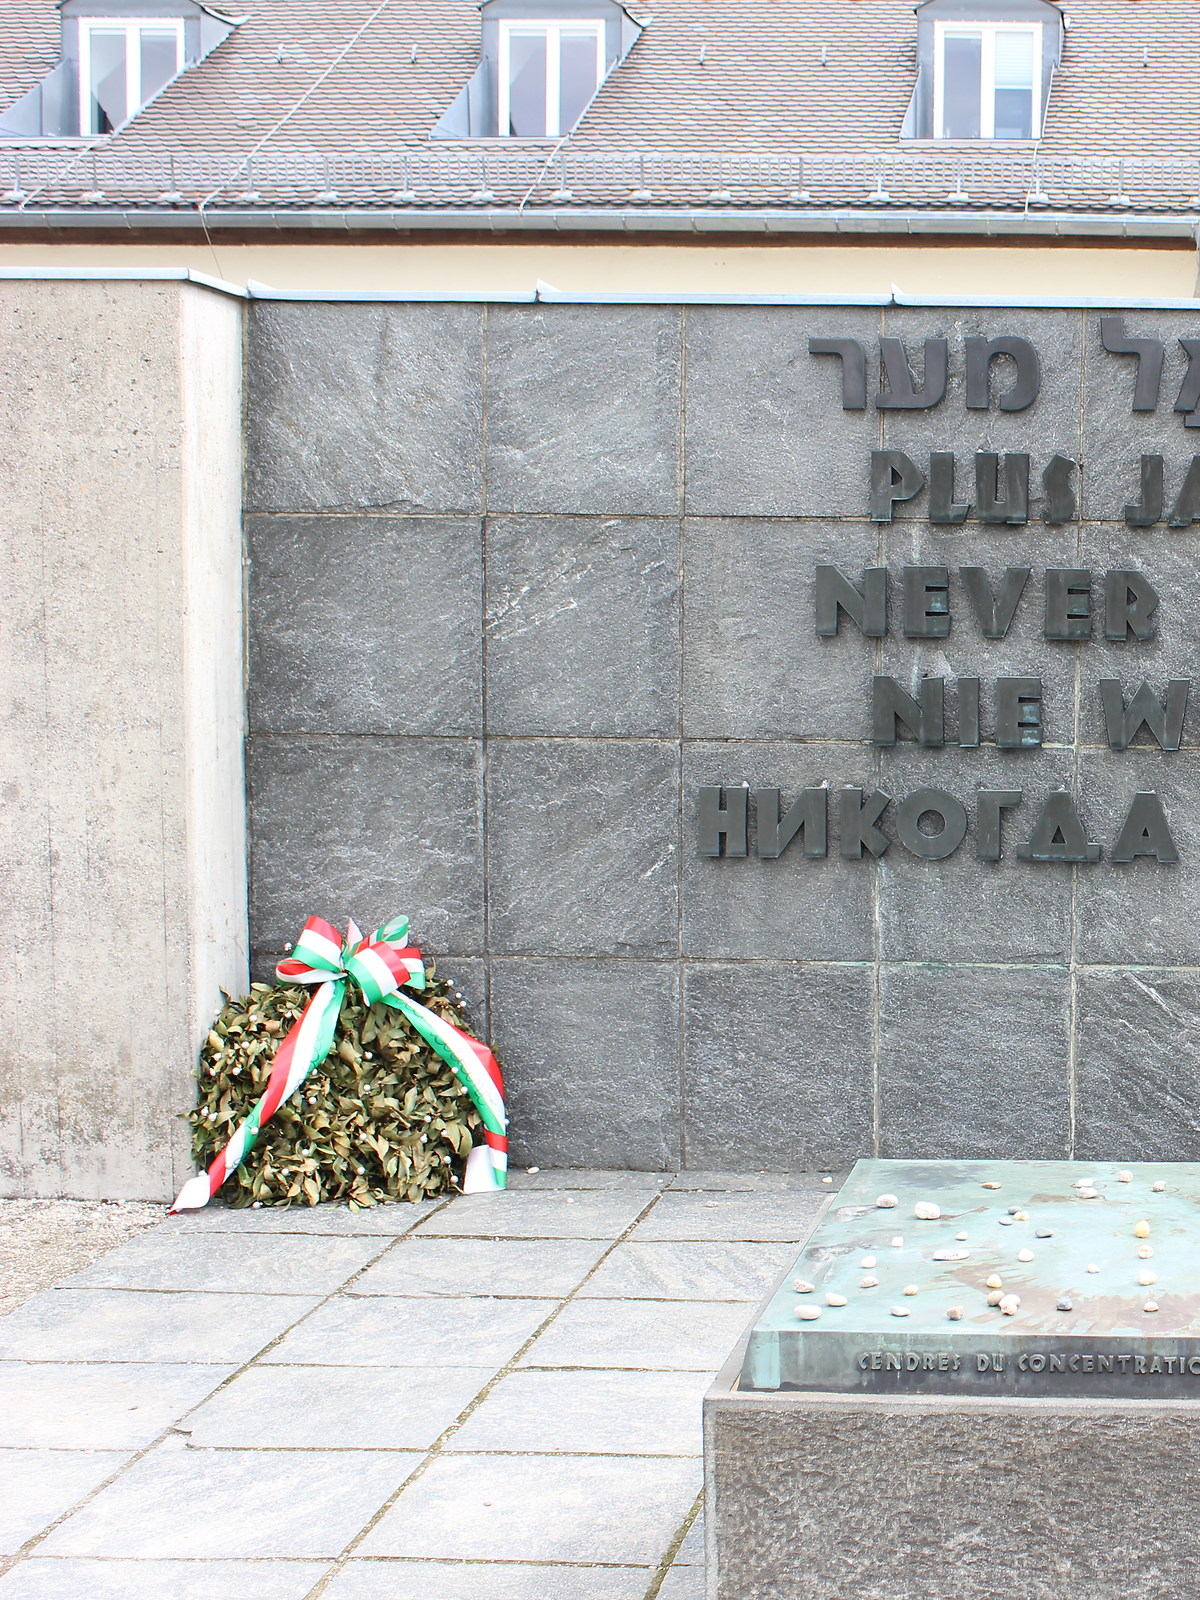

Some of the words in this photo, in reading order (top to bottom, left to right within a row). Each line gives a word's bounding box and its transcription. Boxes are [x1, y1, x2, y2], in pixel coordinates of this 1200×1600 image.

[808, 336, 1041, 411] מער
[870, 449, 1077, 524] PLUS
[815, 565, 1160, 641] NEVER
[873, 675, 1043, 748] NIE
[699, 785, 1179, 863] НИКОГДА
[857, 1351, 961, 1372] CENDRES
[976, 1353, 1004, 1372] DU
